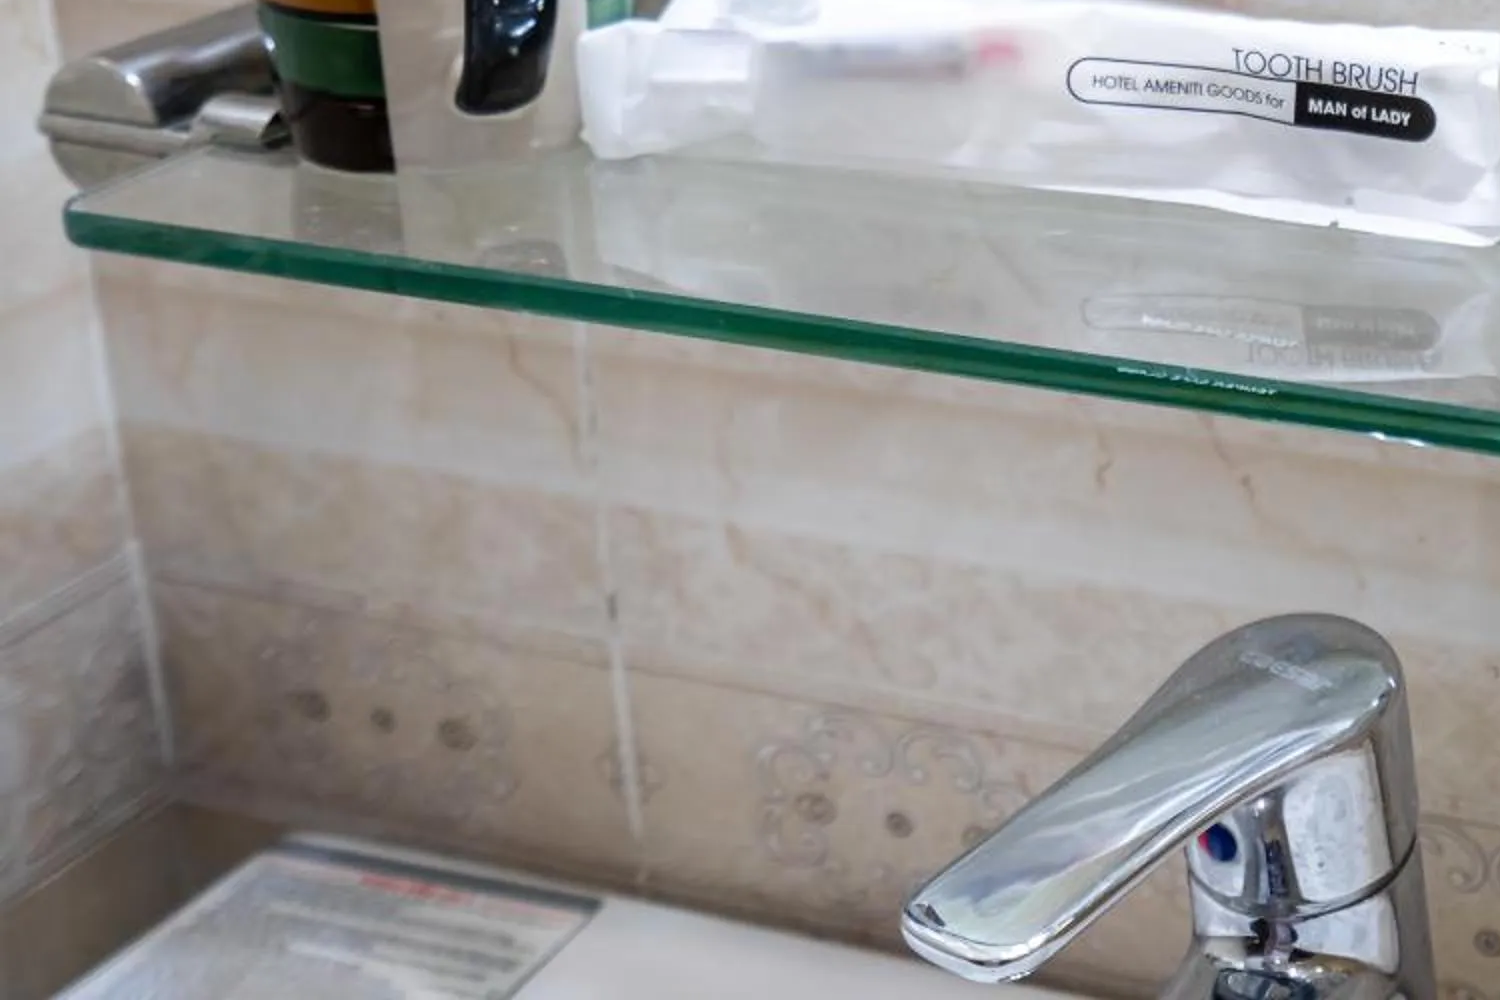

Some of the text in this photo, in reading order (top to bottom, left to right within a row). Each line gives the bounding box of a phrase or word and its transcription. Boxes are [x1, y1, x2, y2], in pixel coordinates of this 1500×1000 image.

[1232, 47, 1419, 95] TOOTH BRUSH
[1092, 74, 1285, 109] HOTEL AMENITI GOODS for
[1308, 97, 1412, 127] MAN of LADY
